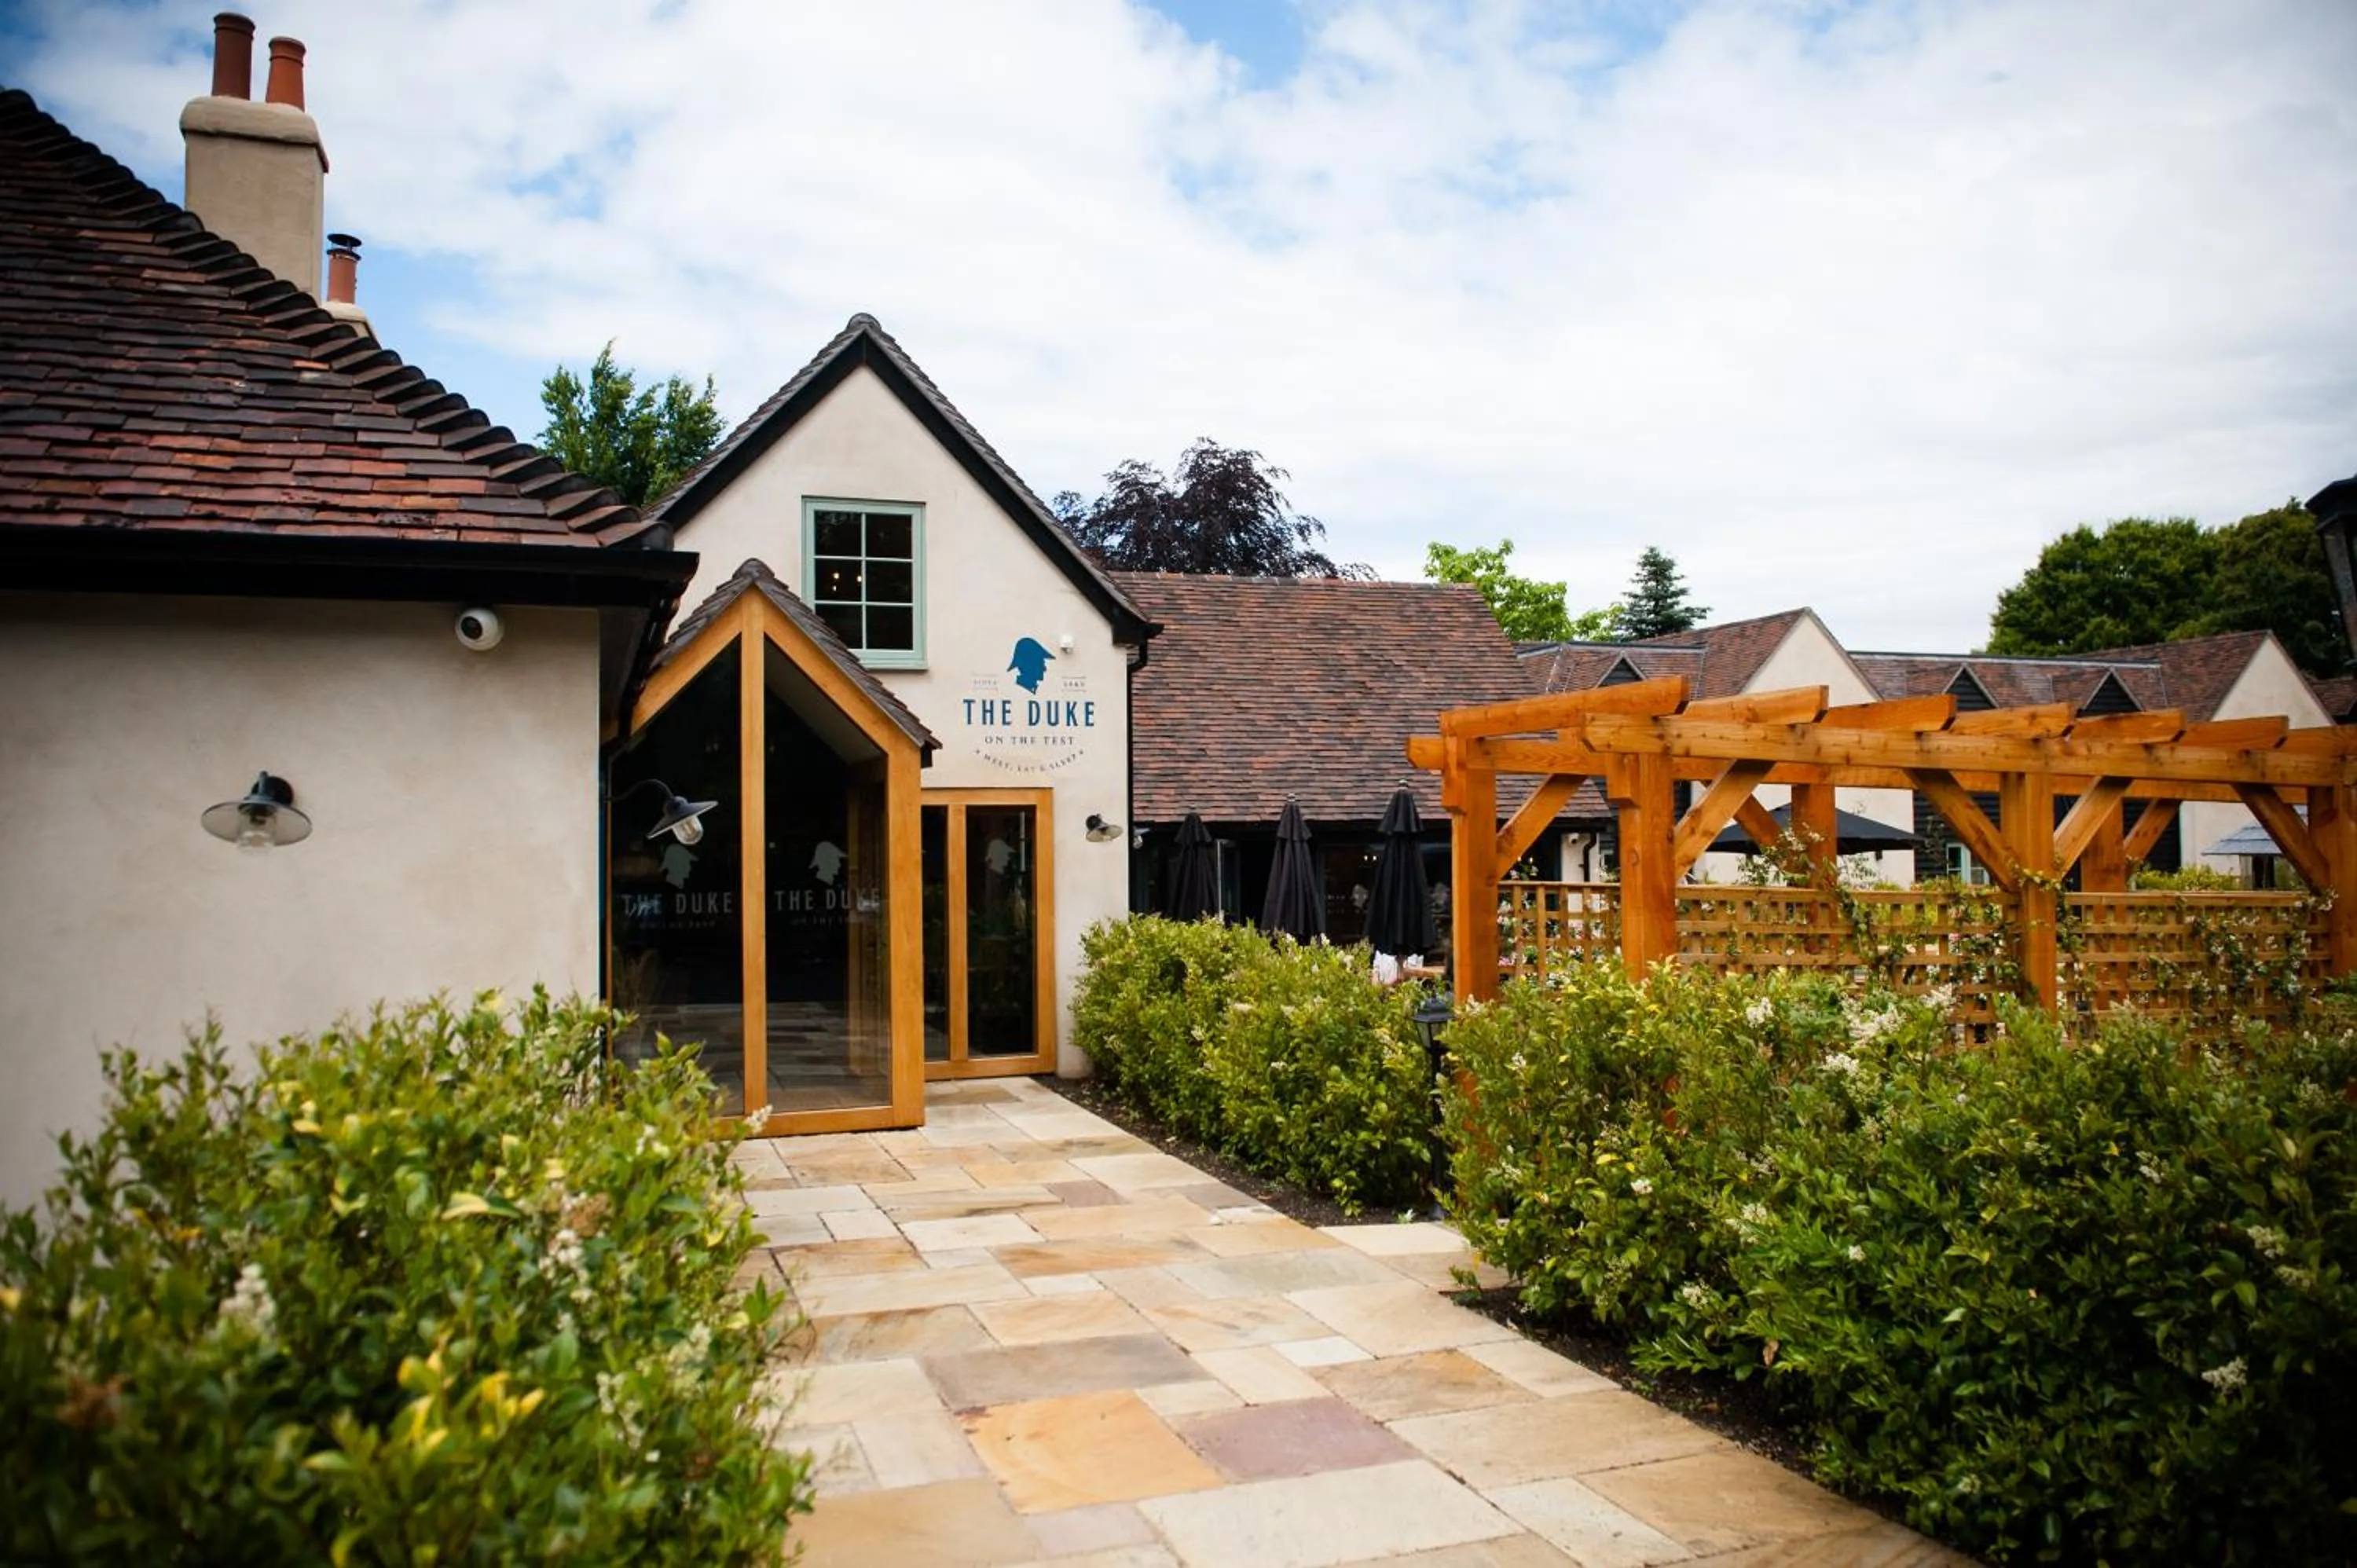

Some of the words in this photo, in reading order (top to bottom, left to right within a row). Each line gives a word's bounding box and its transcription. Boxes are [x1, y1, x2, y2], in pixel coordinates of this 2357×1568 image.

[962, 698, 1012, 726] THE
[1028, 700, 1095, 727] DUKE
[984, 735, 1004, 745] ON
[1010, 735, 1037, 745] THE
[1043, 735, 1075, 746] TEST
[619, 893, 663, 918] THE
[675, 892, 733, 914] DUKE
[774, 888, 815, 911] THE
[825, 886, 881, 913] DUKE
